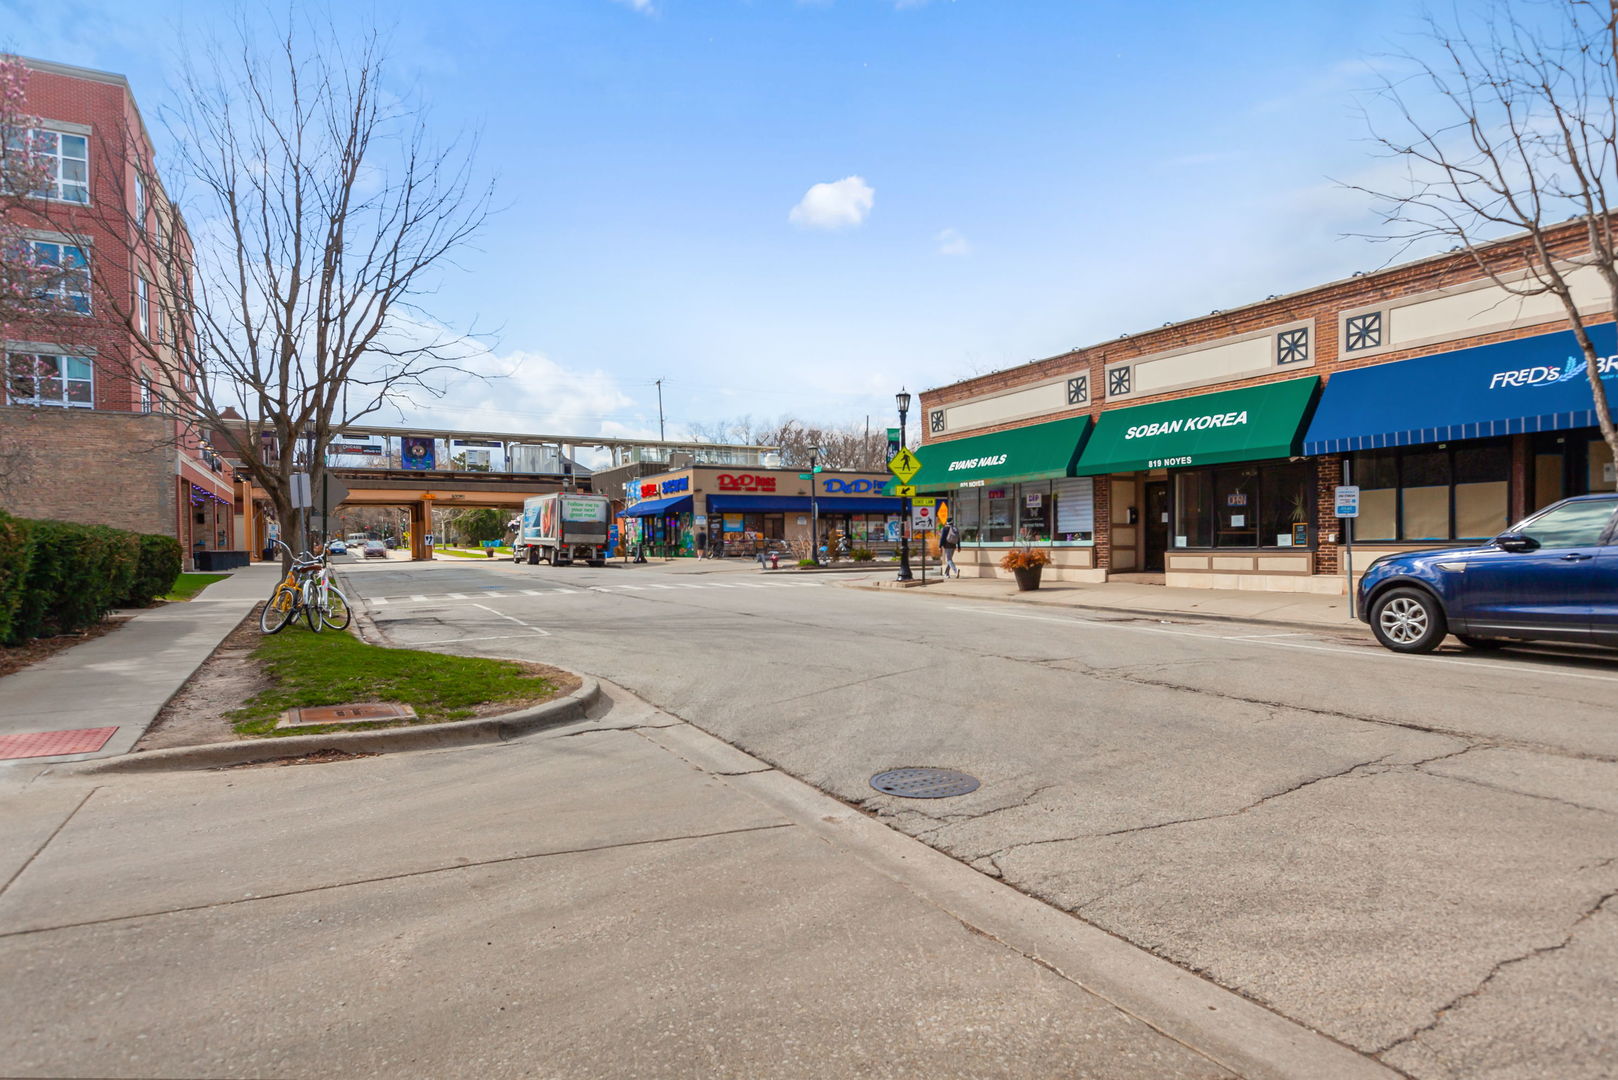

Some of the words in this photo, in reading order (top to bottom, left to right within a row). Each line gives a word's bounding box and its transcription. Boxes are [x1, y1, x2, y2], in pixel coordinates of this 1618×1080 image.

[1125, 419, 1183, 440] SOBAN
[1184, 411, 1248, 431] KOREA
[948, 458, 979, 472] EVANS
[978, 454, 1008, 468] NAILS
[1148, 460, 1162, 468] 819
[1164, 456, 1192, 467] NOYES
